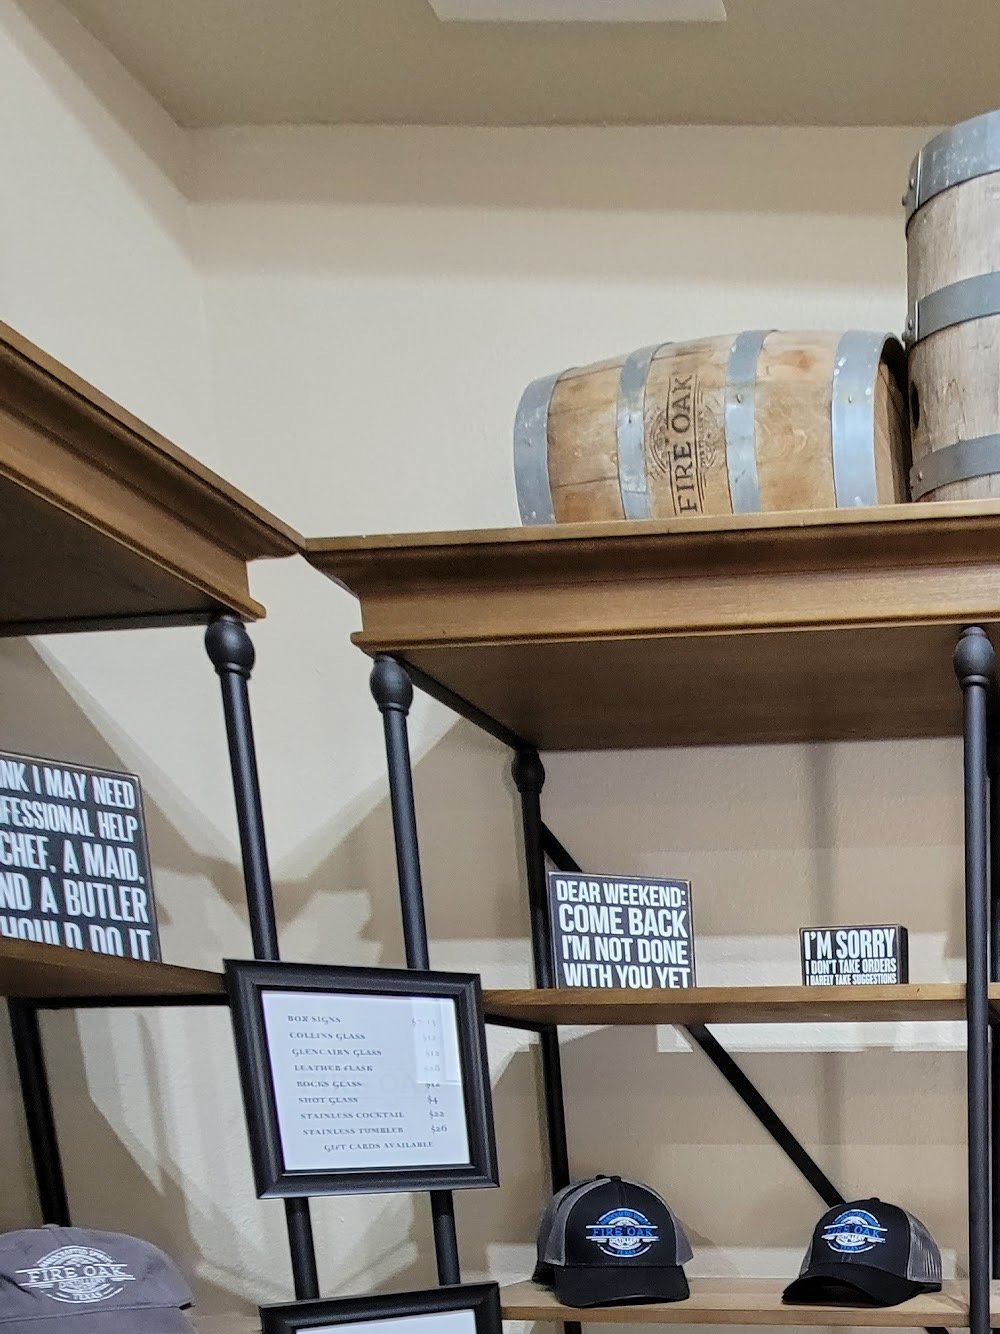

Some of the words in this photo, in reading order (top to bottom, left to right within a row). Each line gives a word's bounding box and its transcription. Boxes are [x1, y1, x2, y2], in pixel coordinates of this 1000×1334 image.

[671, 374, 693, 434] OAK
[673, 441, 698, 514] FIRE
[0, 759, 29, 793] NK
[32, 765, 42, 794] I
[43, 767, 87, 802] MAY
[91, 775, 136, 809] NEED
[0, 795, 94, 838] FESSIONAL
[97, 810, 139, 843] HELP
[63, 840, 80, 875] A
[82, 842, 145, 885] MAID,
[0, 871, 32, 912] ND
[40, 876, 60, 915] A
[63, 879, 150, 924] BUTLER
[555, 880, 601, 904] DEAR
[602, 882, 687, 908] WEEKEND:
[558, 903, 625, 935] COME
[627, 907, 689, 938] BACK
[128, 928, 151, 962] IT
[561, 935, 591, 961] I'M
[594, 936, 633, 963] NOT
[637, 938, 689, 965] DONE
[803, 931, 833, 960] I'M
[835, 928, 896, 959] SORRY
[562, 962, 613, 988] WITH
[615, 964, 653, 989] YOU
[655, 966, 690, 989] YET
[805, 961, 810, 974] I
[811, 959, 837, 975] DON'T
[838, 959, 861, 974] TAKE
[862, 958, 897, 973] ORDERS
[806, 975, 810, 986] I
[810, 974, 834, 986] BARELY
[835, 973, 852, 986] TAKE
[852, 973, 897, 985] SUGGESTIONS
[311, 1016, 341, 1024] SIGNS
[335, 1033, 366, 1041] GLASS
[291, 1048, 351, 1057] GLENCAIRN
[352, 1049, 382, 1057] GLASS
[294, 1064, 341, 1072] LEATHER
[328, 1097, 358, 1105] GLASS
[427, 1095, 438, 1105] $4
[300, 1112, 354, 1120] STAINLESS
[355, 1111, 405, 1119] COCKTAIL
[429, 1109, 445, 1120] $22
[324, 1144, 347, 1152] GIFT
[383, 1140, 433, 1149] AVAILABLE
[592, 1227, 623, 1237] FIRE
[626, 1226, 653, 1237] OAK
[854, 1225, 880, 1238] OAK
[27, 1266, 78, 1283] FIRE
[83, 1265, 126, 1277] OAK
[72, 1292, 104, 1300] TEXAS
